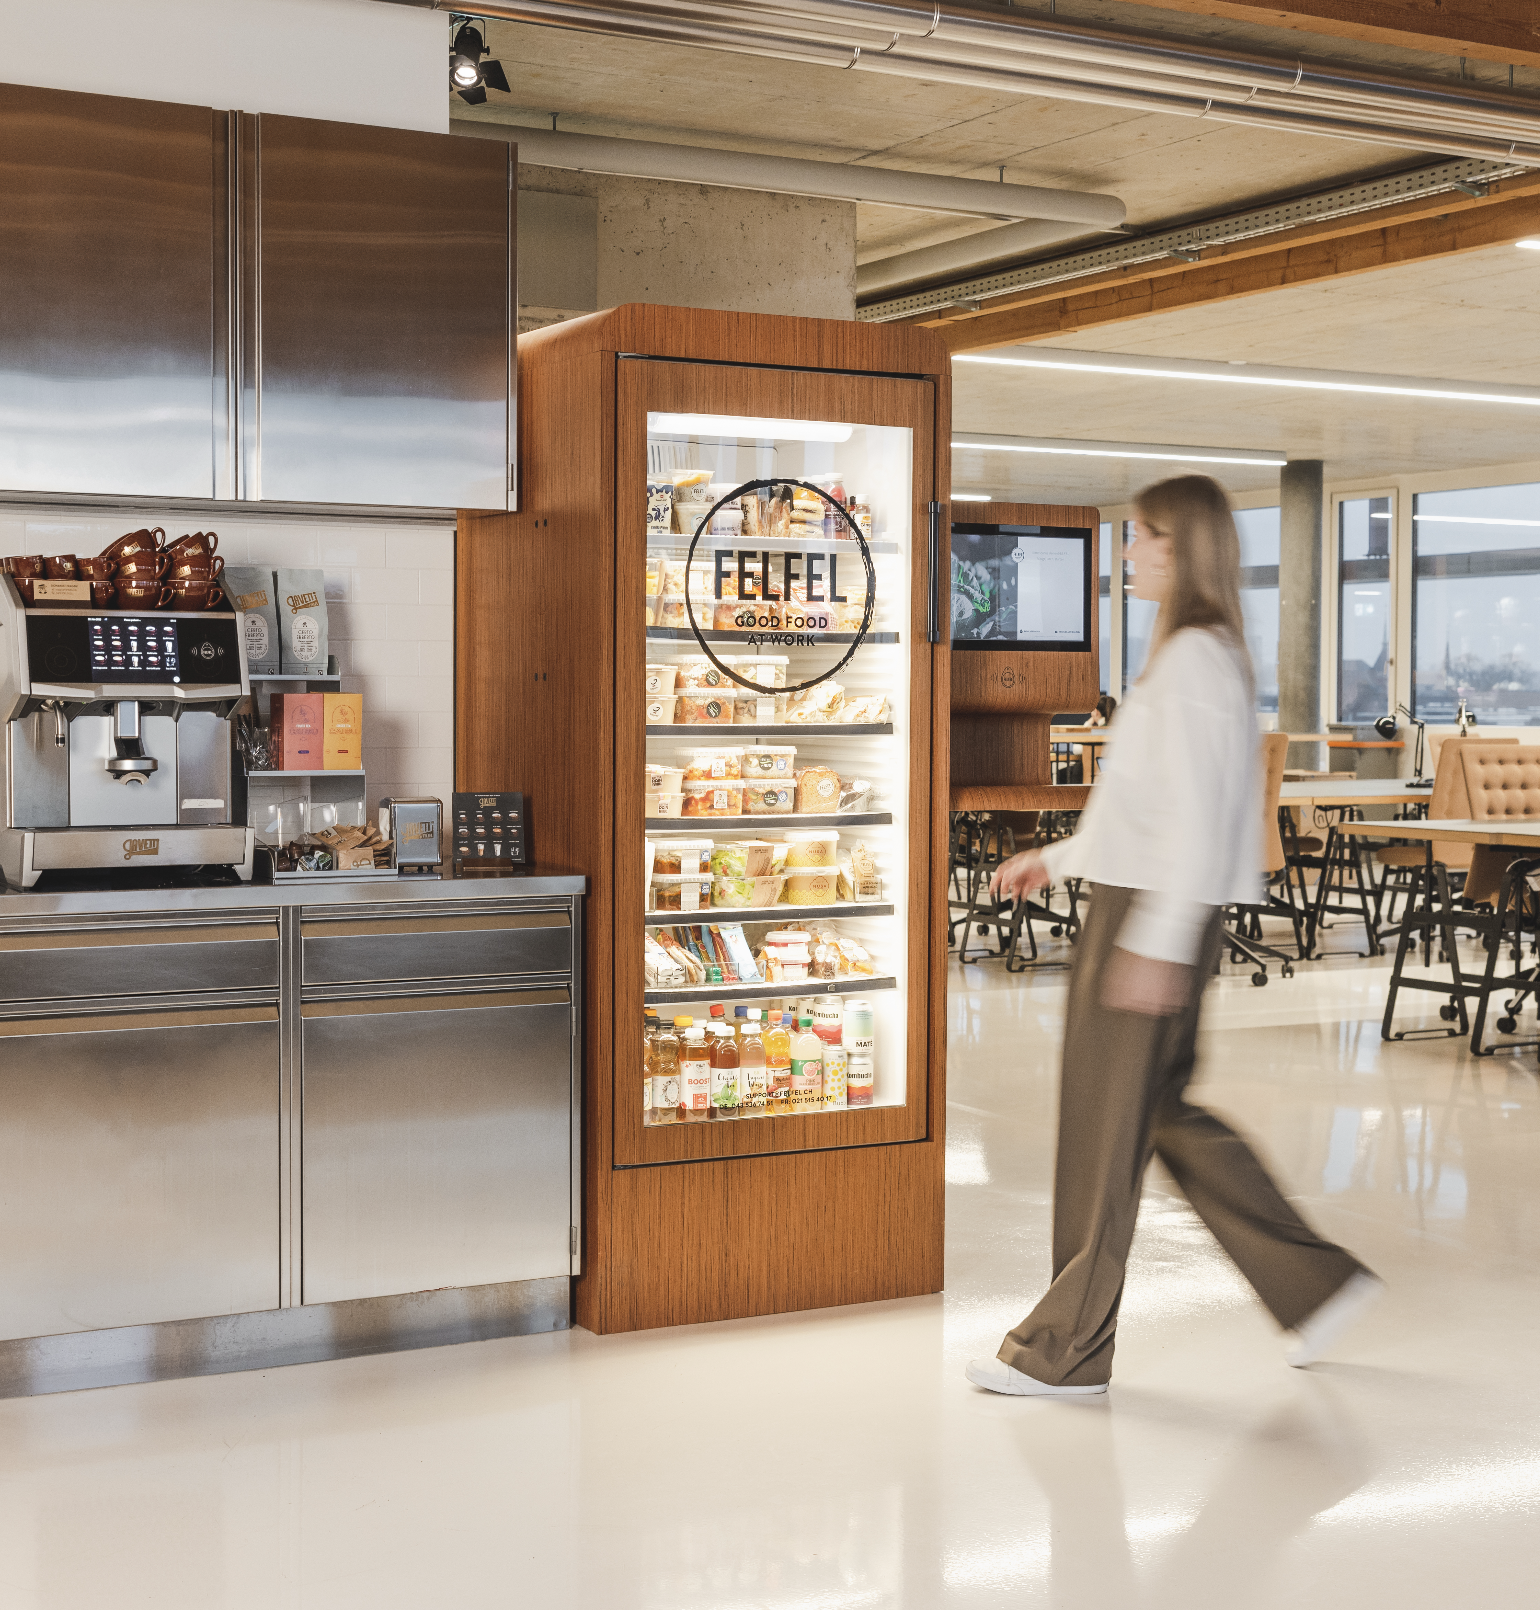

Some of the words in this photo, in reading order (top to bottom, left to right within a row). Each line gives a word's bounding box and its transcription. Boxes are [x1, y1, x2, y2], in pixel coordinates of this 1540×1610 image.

[714, 549, 848, 603] FELFEL
[735, 615, 780, 628] GOOD
[786, 616, 828, 629] FOOD
[747, 633, 766, 646] AT
[770, 633, 816, 647] WORK
[687, 1077, 710, 1085] BOOST
[791, 1097, 803, 1105] 021
